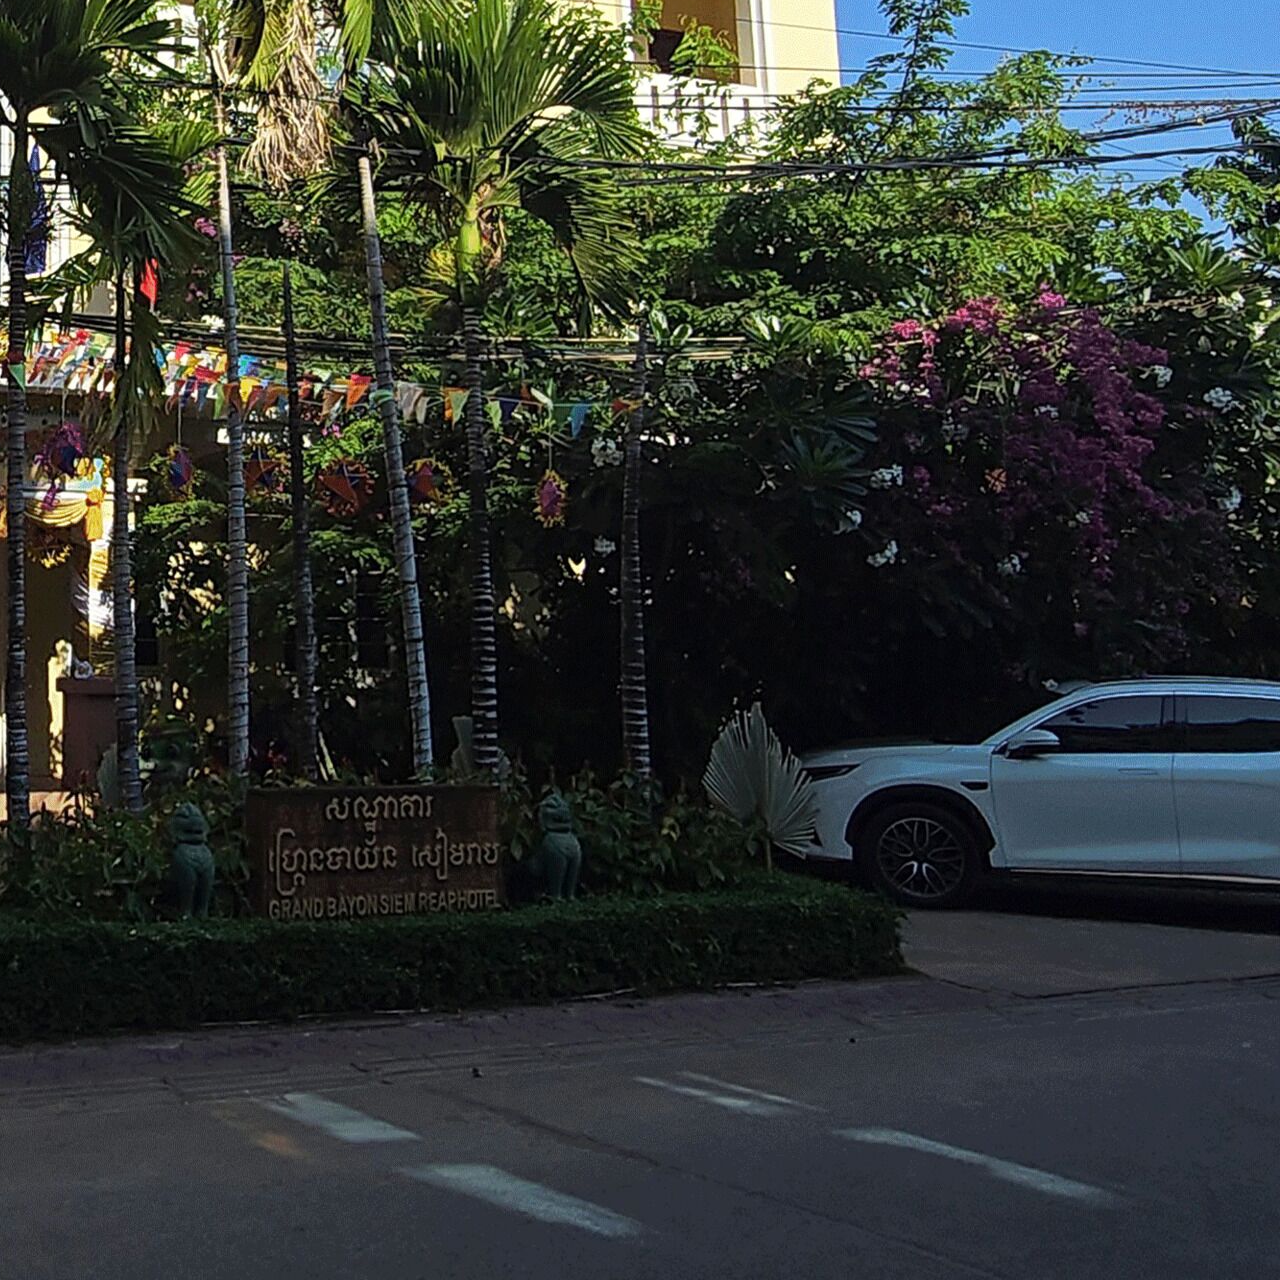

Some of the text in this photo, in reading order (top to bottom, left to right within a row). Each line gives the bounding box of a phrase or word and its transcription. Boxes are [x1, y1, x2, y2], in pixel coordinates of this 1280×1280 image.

[412, 827, 500, 881] សៀមរាប
[269, 888, 502, 920] GRAND BAYON SIEM REAP HOTEL
